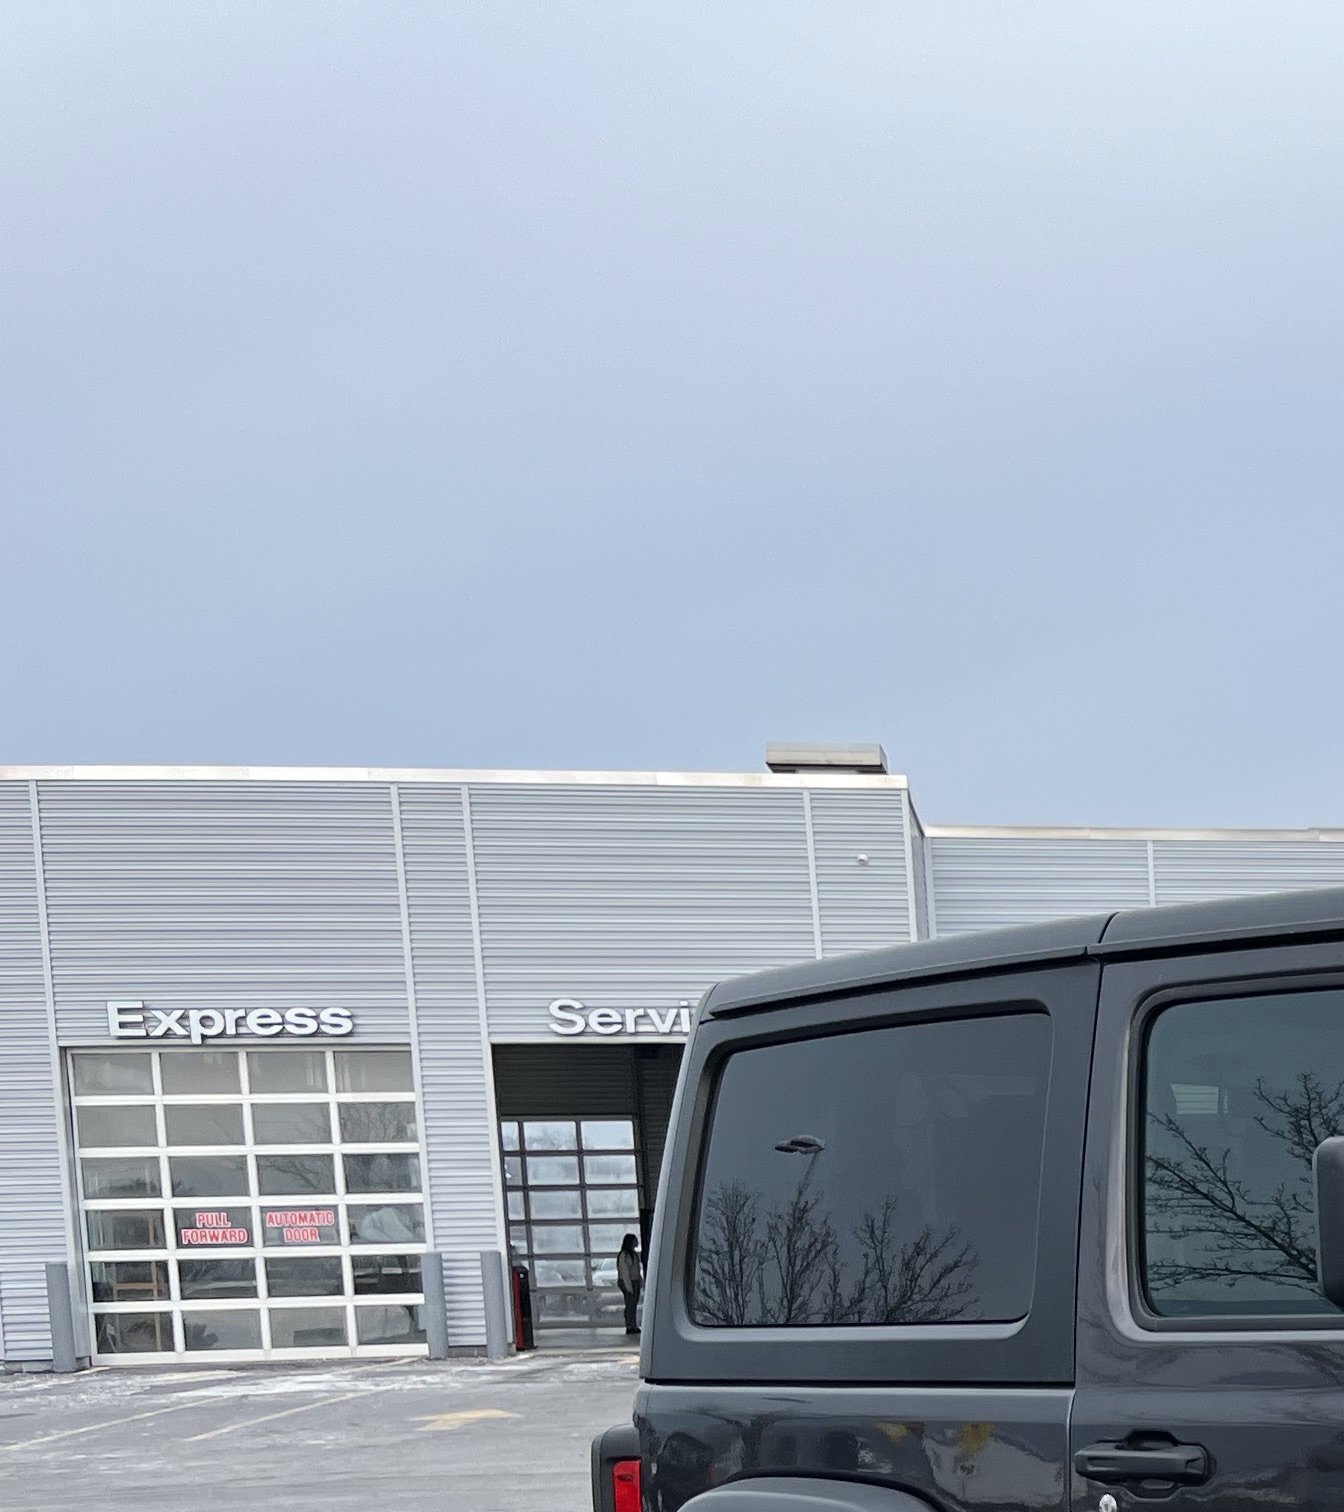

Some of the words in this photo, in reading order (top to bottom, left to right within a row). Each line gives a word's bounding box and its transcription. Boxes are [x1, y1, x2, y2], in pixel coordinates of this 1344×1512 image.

[106, 1000, 354, 1044] Express
[549, 999, 692, 1035] Servi
[196, 1212, 231, 1228] PULL
[266, 1210, 334, 1227] AUTOMATIC
[181, 1228, 248, 1244] FORWARD
[284, 1227, 320, 1242] DOOR
